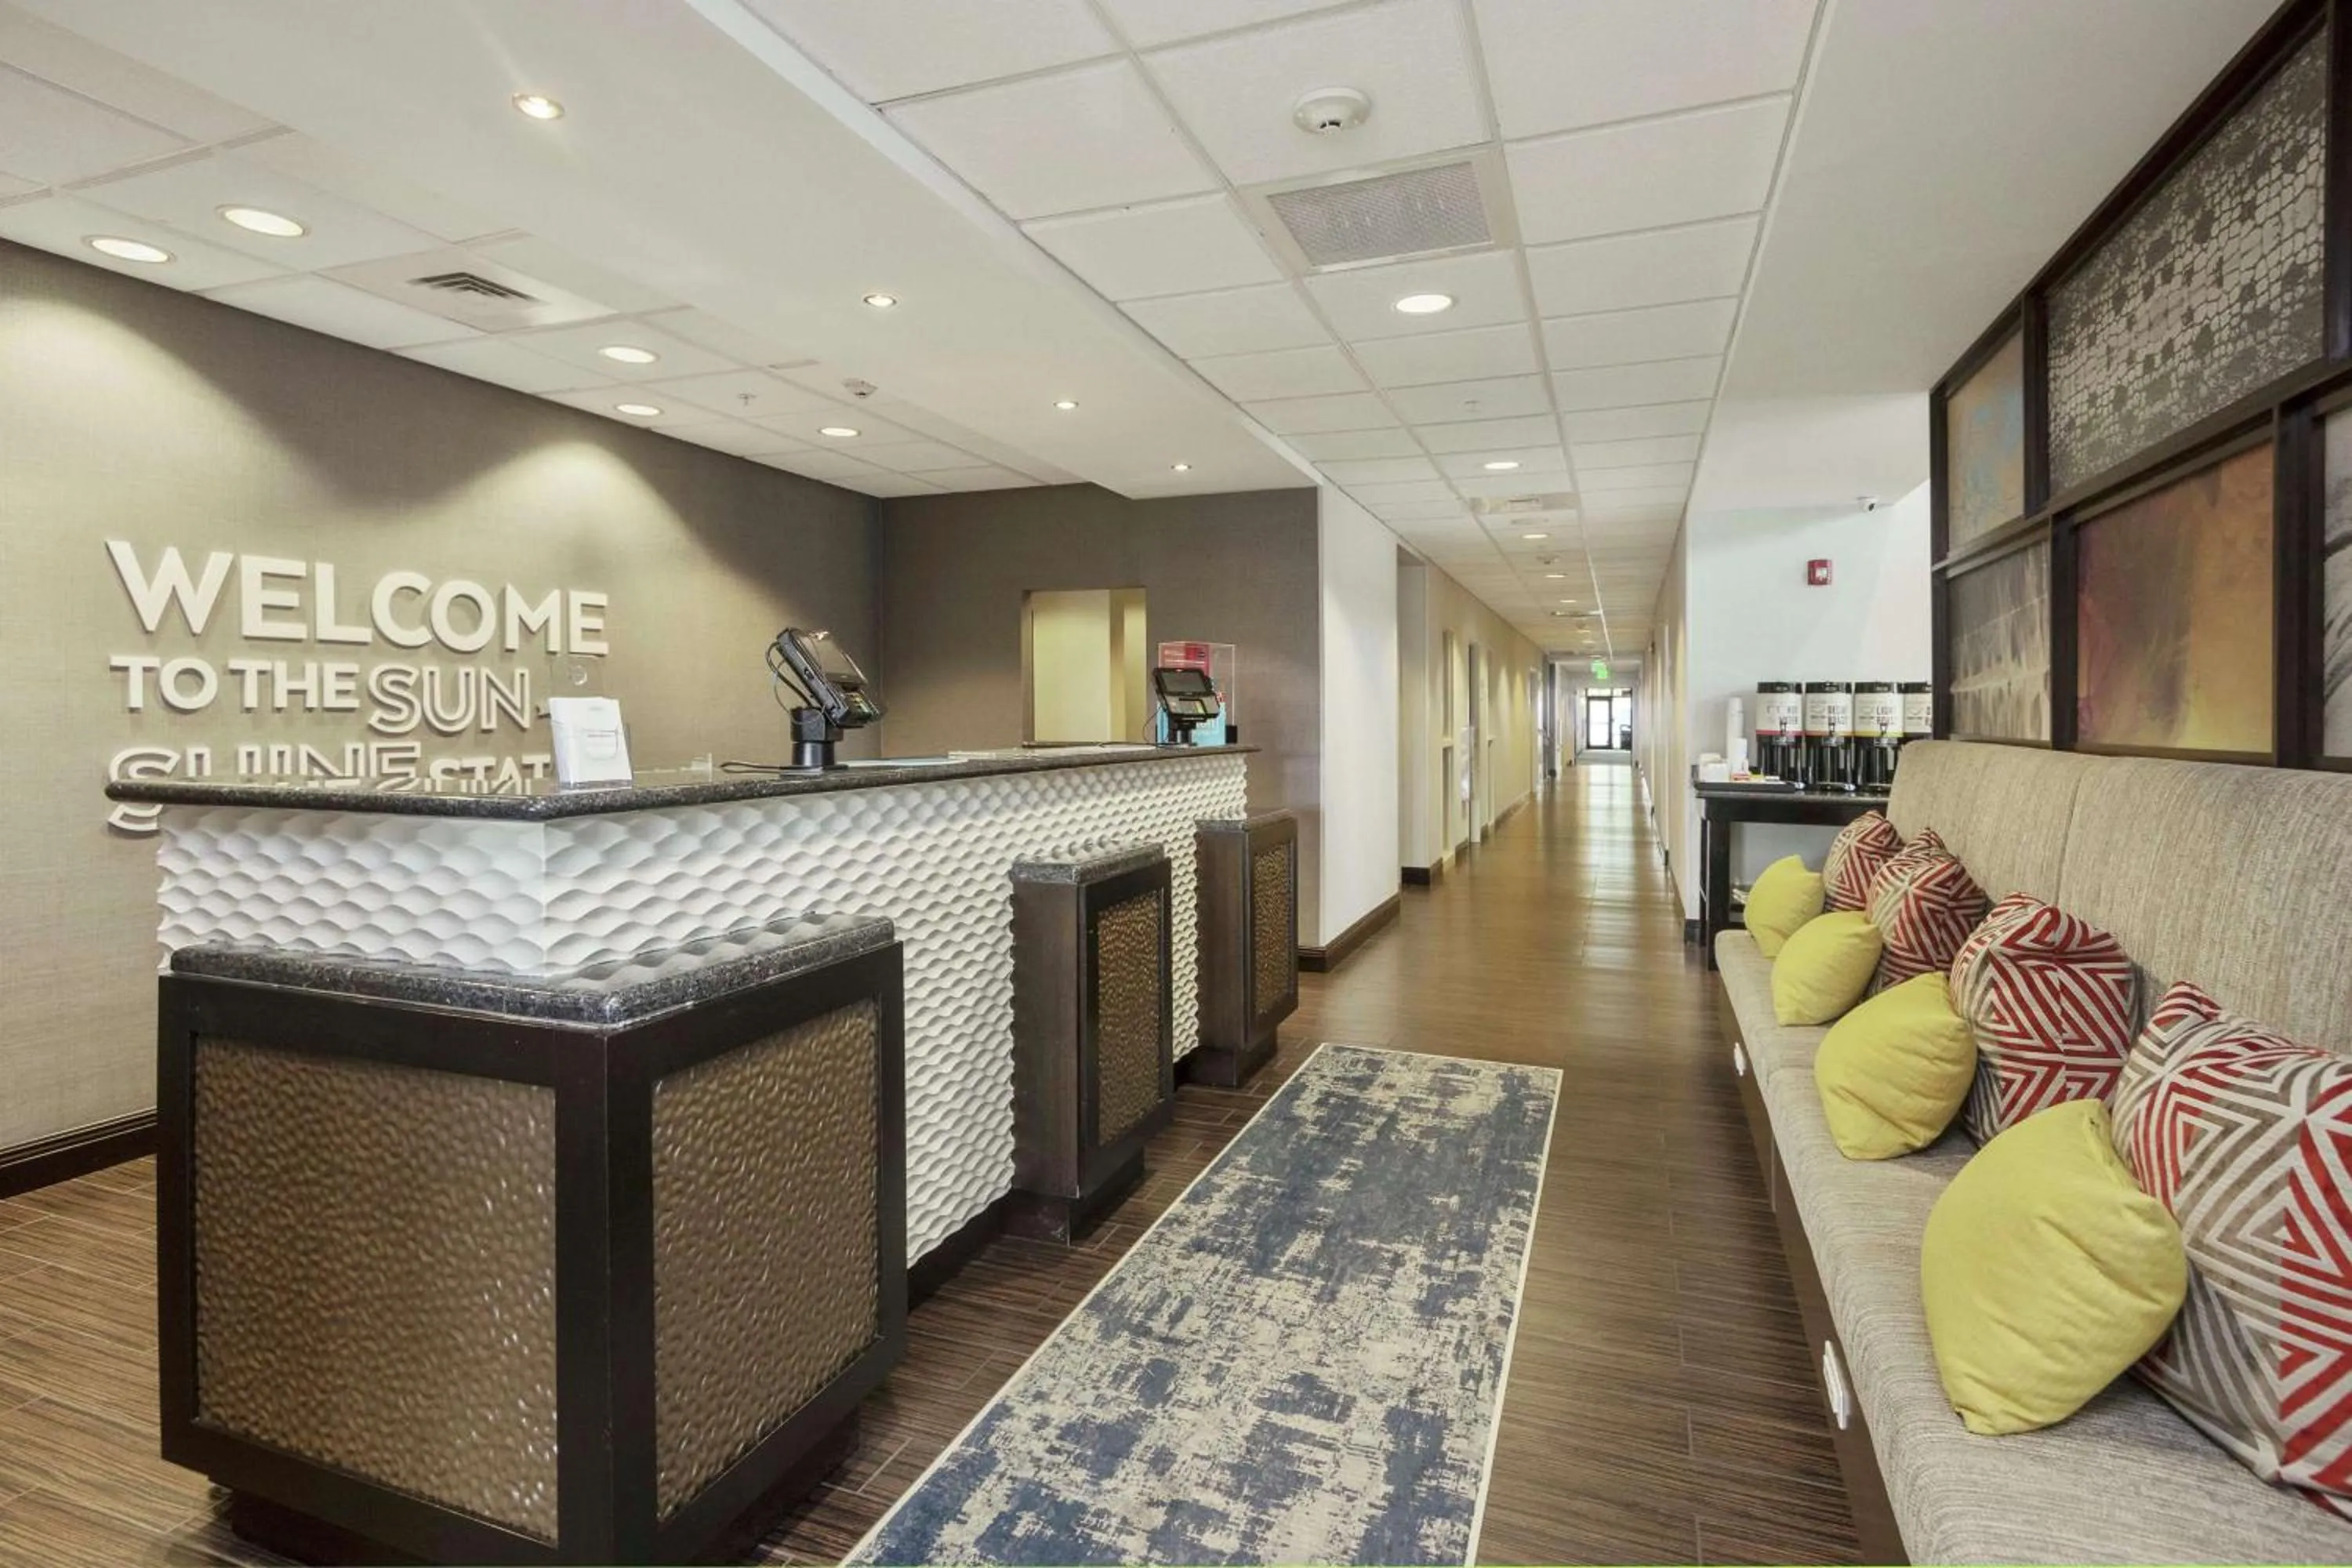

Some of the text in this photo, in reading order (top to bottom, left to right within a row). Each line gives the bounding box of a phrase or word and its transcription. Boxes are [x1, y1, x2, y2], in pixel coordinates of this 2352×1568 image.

[105, 539, 609, 655] WELCOME
[110, 655, 218, 710] TO
[229, 659, 360, 709] THE
